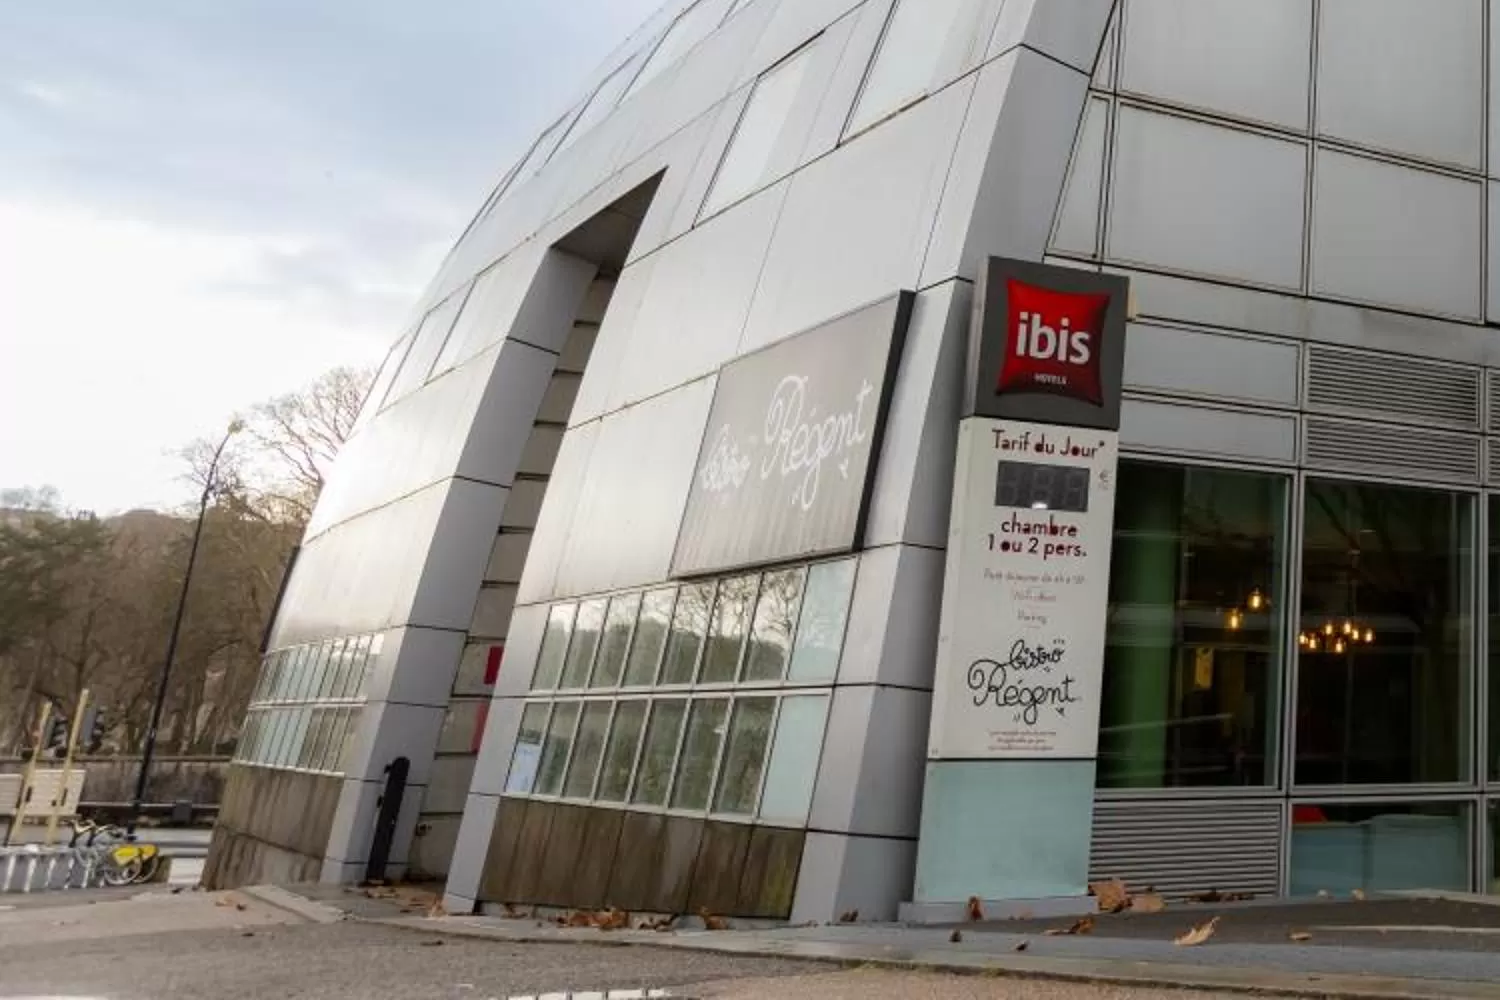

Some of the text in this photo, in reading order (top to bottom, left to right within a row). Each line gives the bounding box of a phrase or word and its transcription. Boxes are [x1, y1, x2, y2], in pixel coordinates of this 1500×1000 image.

[1015, 311, 1091, 365] ibis
[992, 428, 1030, 451] Tarif
[1035, 433, 1055, 454] du
[1001, 511, 1078, 537] chambre
[988, 533, 1088, 560] 1 ou 2 pers.
[967, 658, 1077, 725] Régent
